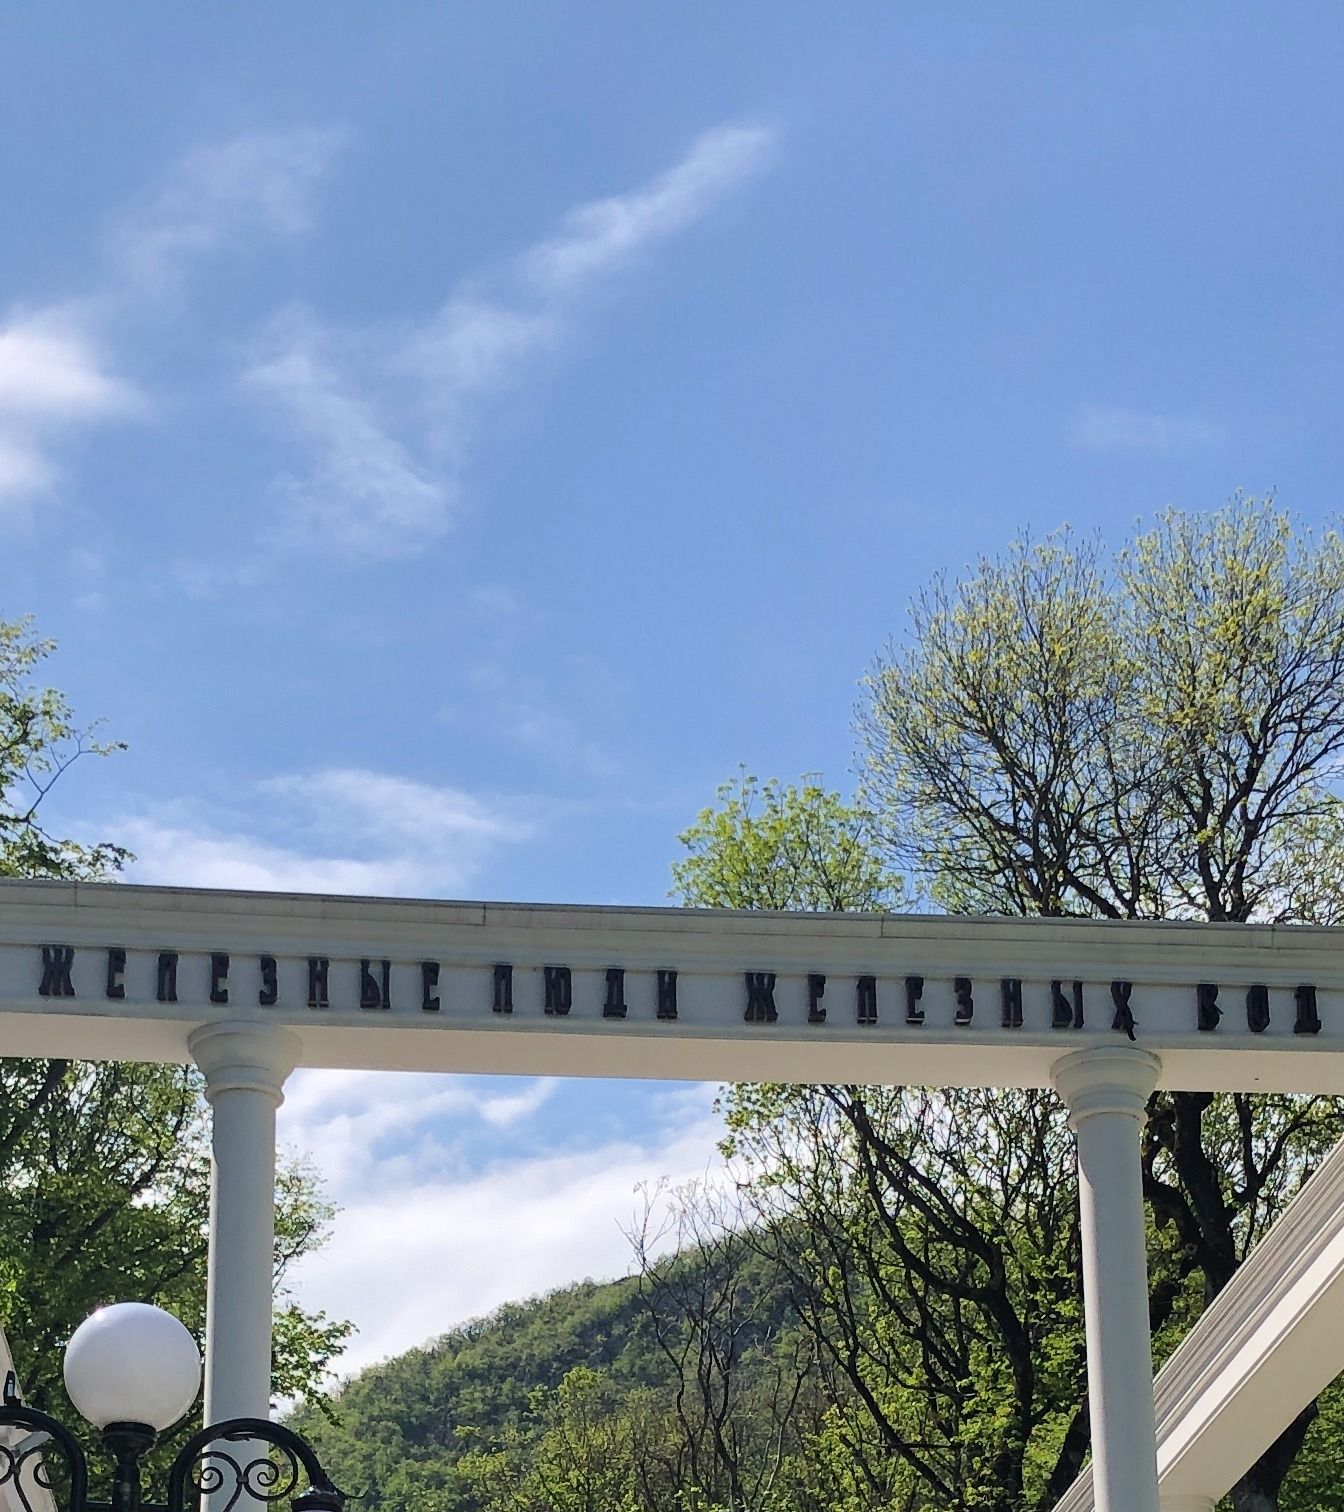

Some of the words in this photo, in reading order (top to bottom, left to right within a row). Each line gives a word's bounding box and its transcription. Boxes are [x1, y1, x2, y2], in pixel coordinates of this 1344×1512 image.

[38, 945, 441, 1011] ЖЕЛЕЗНЫЕ
[492, 962, 679, 1020] ЛЮДИ
[743, 971, 1136, 1036] ЖЕЛЕЗНЫХ
[1196, 982, 1323, 1035] ВОД
